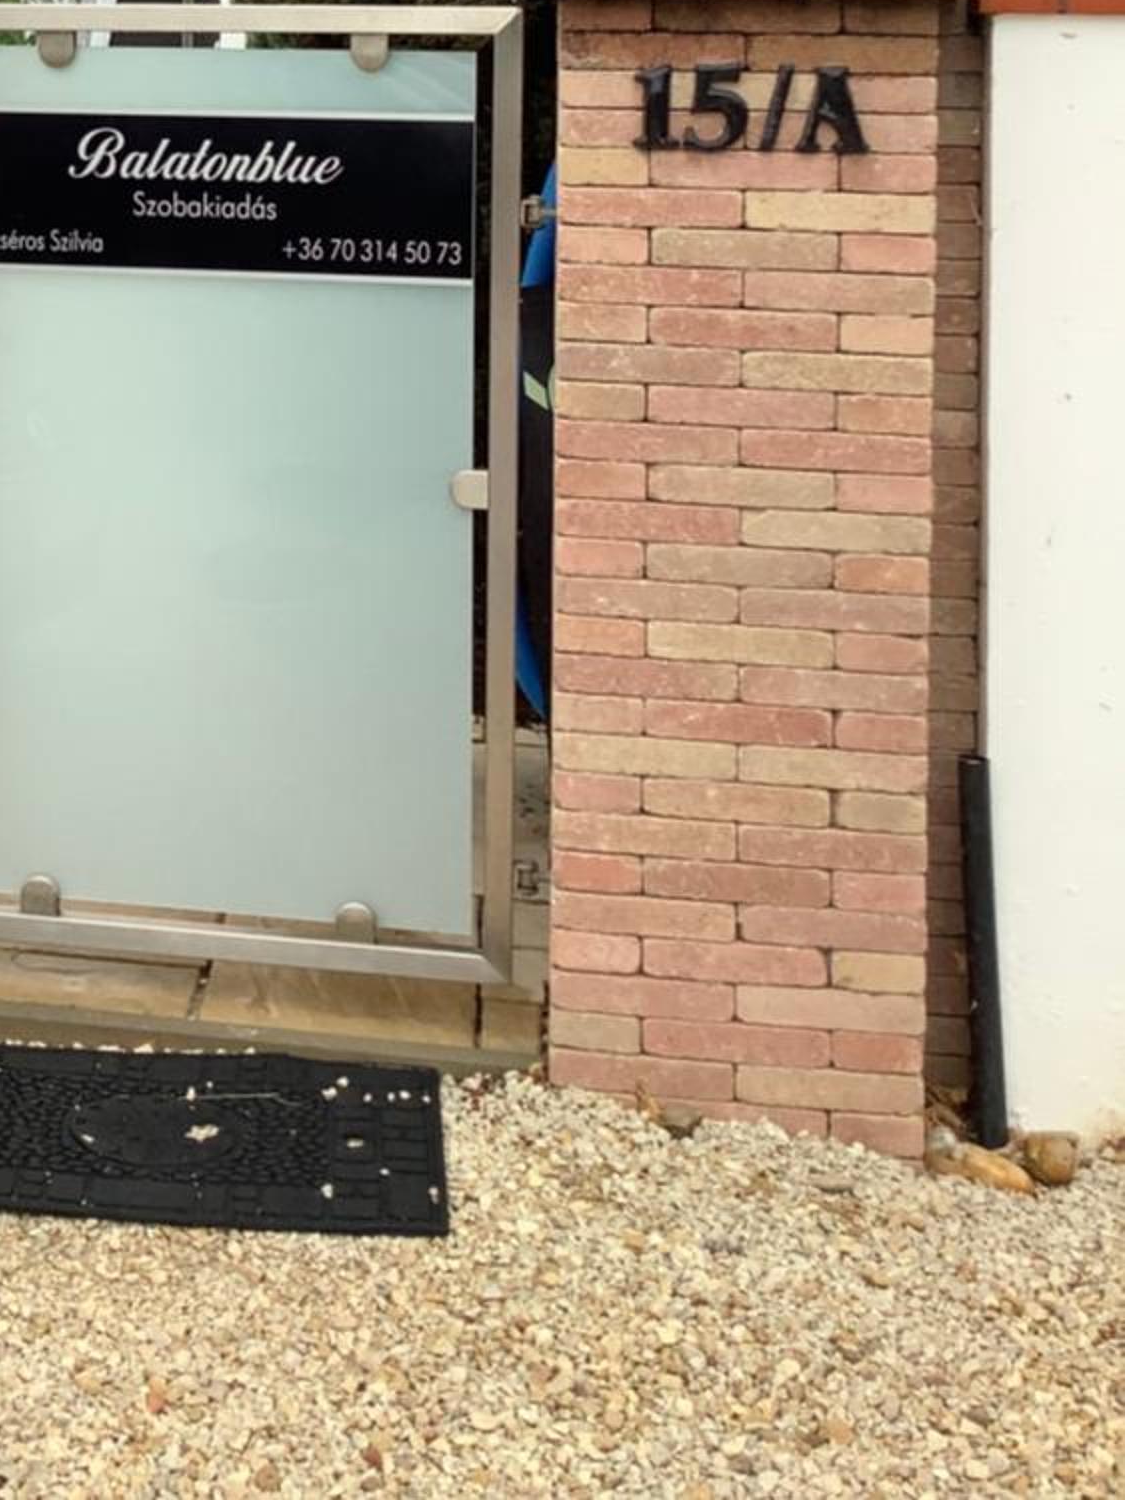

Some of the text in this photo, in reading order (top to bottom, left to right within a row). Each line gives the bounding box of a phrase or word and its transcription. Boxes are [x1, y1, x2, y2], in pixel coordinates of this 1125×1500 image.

[632, 62, 871, 154] 15/A
[67, 126, 344, 186] Balatonblue
[132, 190, 278, 221] Szobakiadás
[49, 228, 104, 254] Szilvia
[282, 236, 463, 266] +36 70 314 50 73
